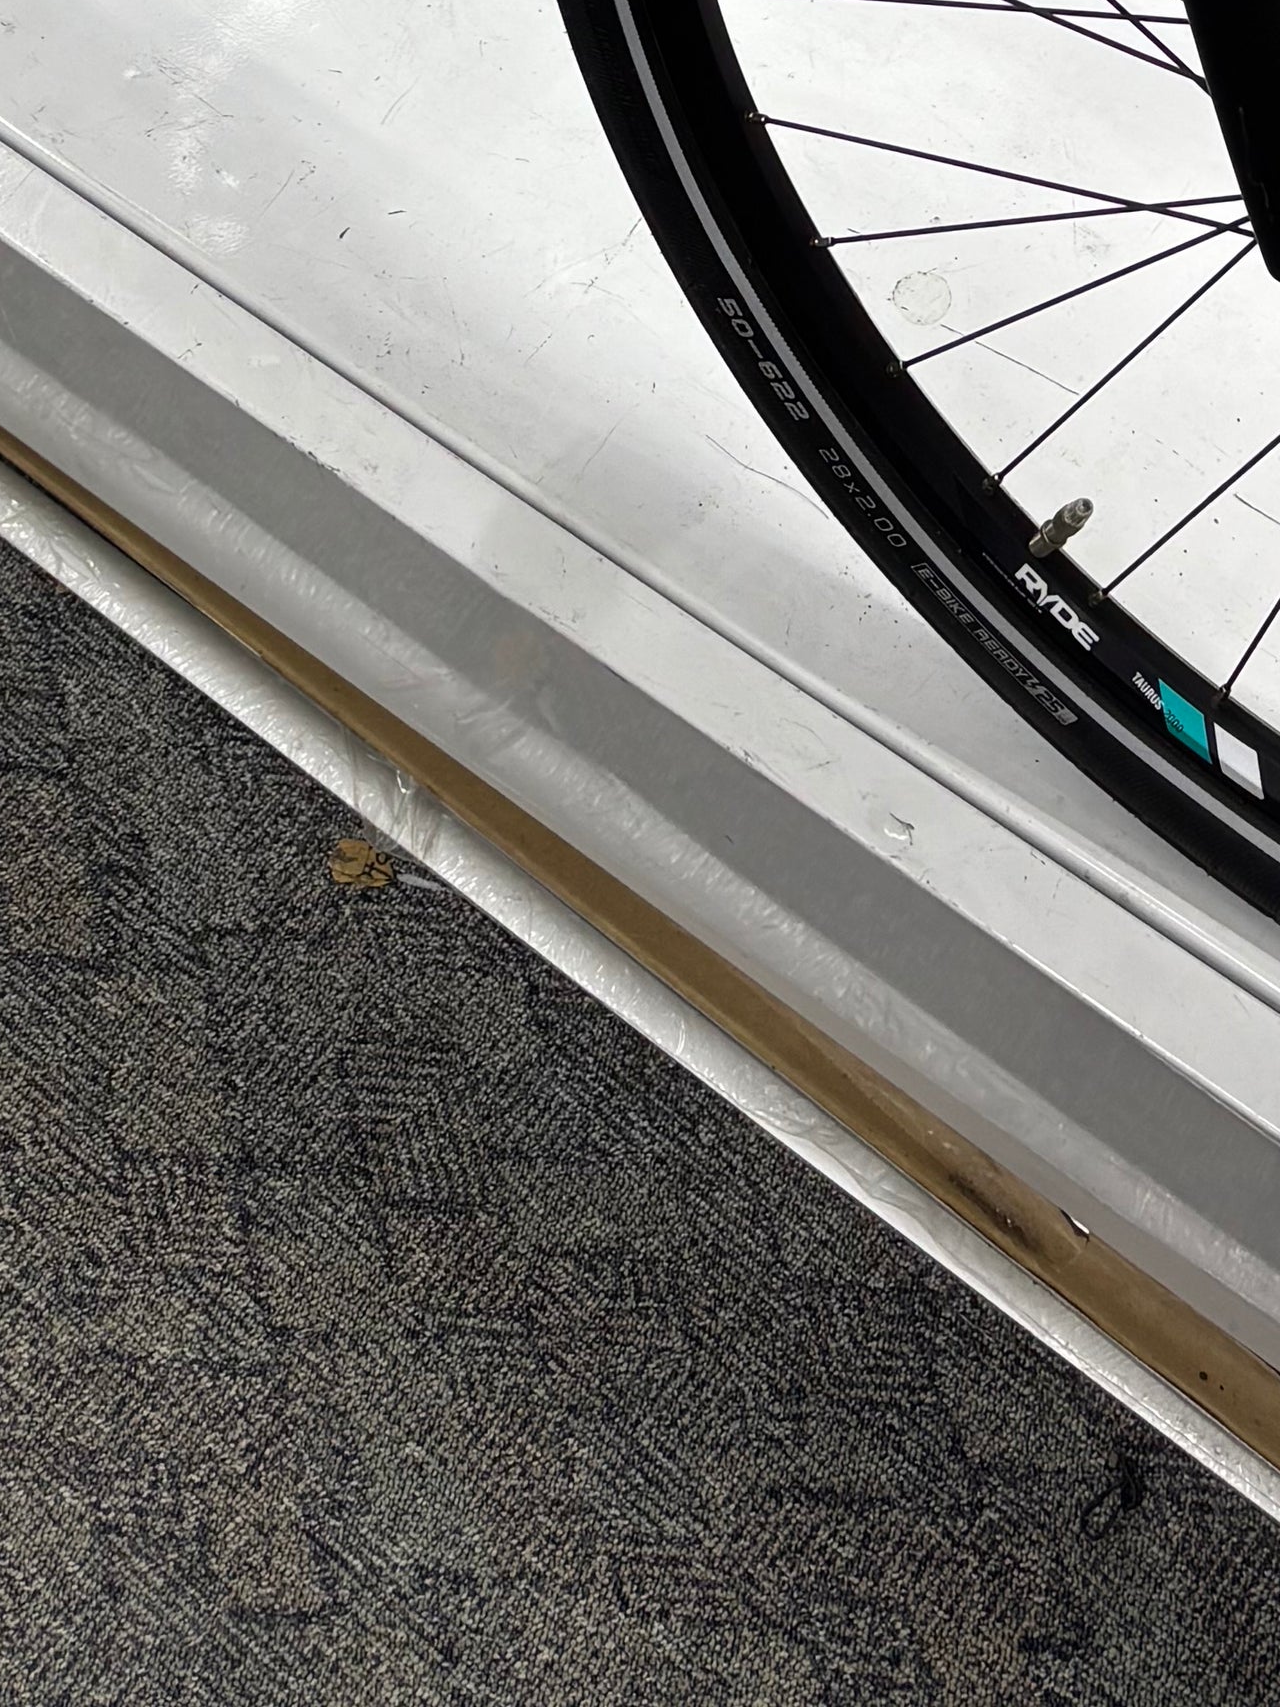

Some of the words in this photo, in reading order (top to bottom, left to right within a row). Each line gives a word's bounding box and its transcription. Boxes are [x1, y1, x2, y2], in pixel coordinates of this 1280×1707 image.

[718, 297, 809, 421] 50-622
[918, 567, 973, 625] E-BIKE
[1014, 563, 1101, 652] RYDE
[1131, 671, 1164, 711] TAURUS
